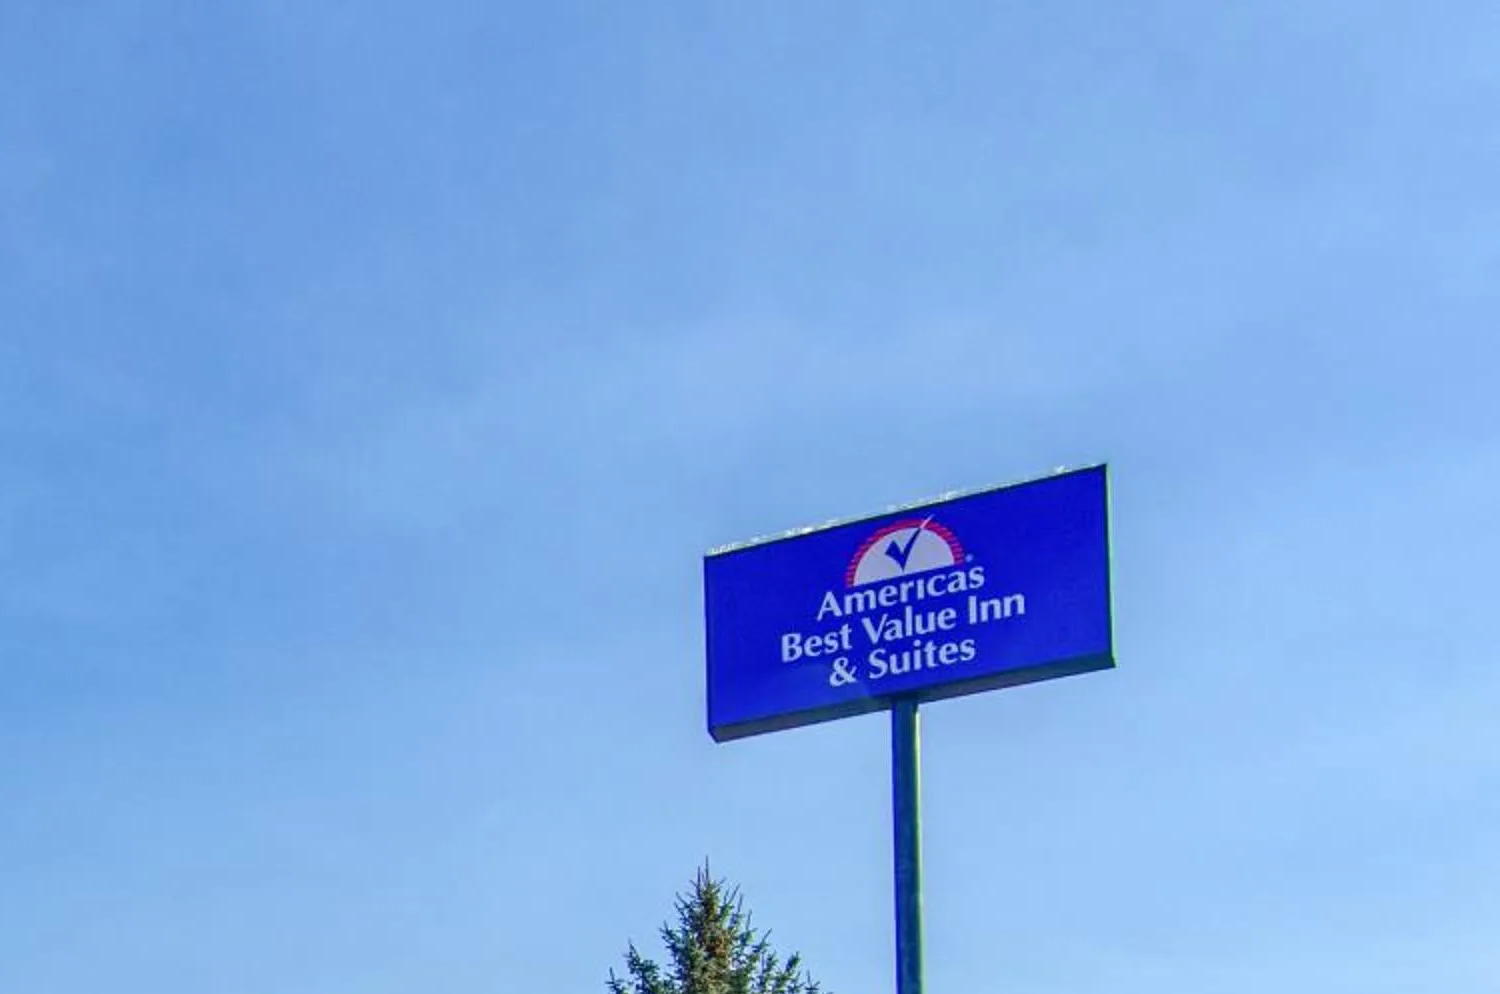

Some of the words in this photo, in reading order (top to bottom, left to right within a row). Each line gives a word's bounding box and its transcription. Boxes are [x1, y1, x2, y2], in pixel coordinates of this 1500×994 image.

[817, 566, 985, 621] Americas
[782, 624, 853, 662] Best
[862, 606, 956, 644] Value
[969, 593, 1025, 624] Inn
[829, 657, 858, 687] &
[868, 638, 976, 679] Suites
